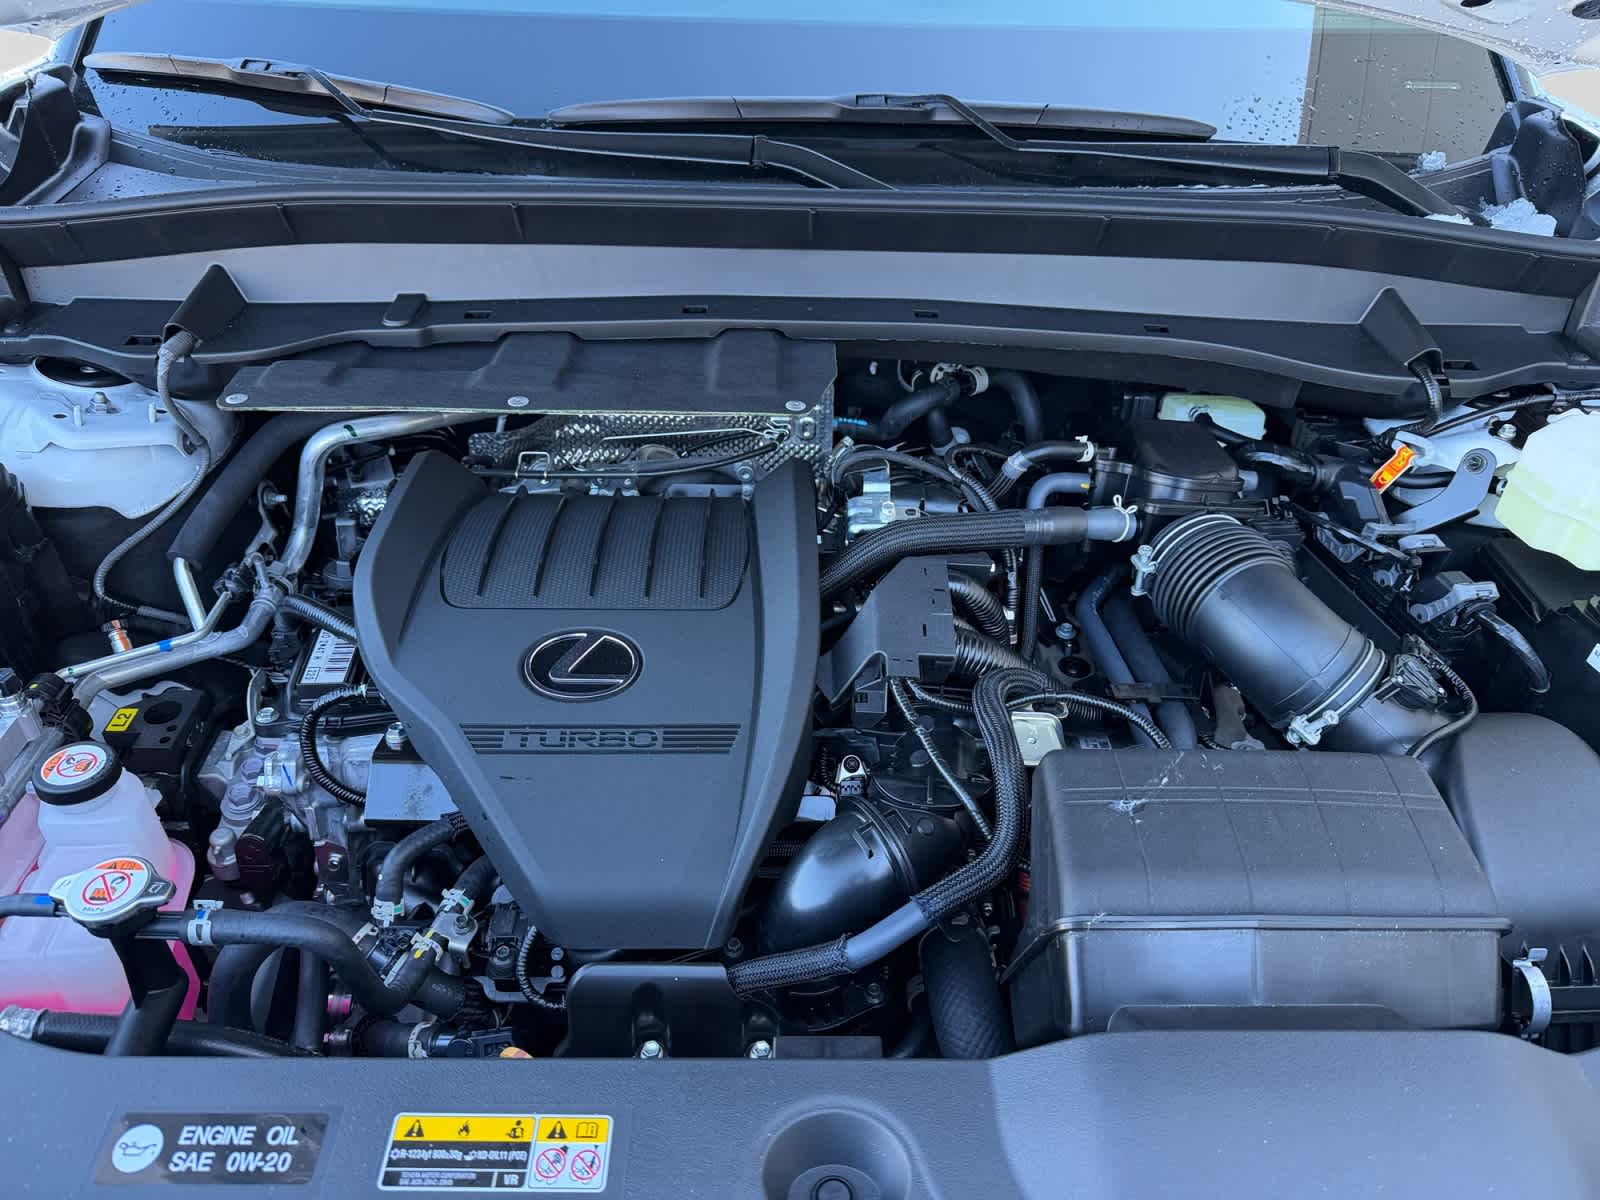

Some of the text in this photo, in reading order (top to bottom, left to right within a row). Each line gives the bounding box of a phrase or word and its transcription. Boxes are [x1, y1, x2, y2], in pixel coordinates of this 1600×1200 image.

[111, 713, 132, 727] L2
[509, 729, 659, 748] TURBO
[177, 1125, 299, 1146] ENGINE OIL
[168, 1151, 292, 1173] SAE 0W-20
[503, 1173, 520, 1186] VR
